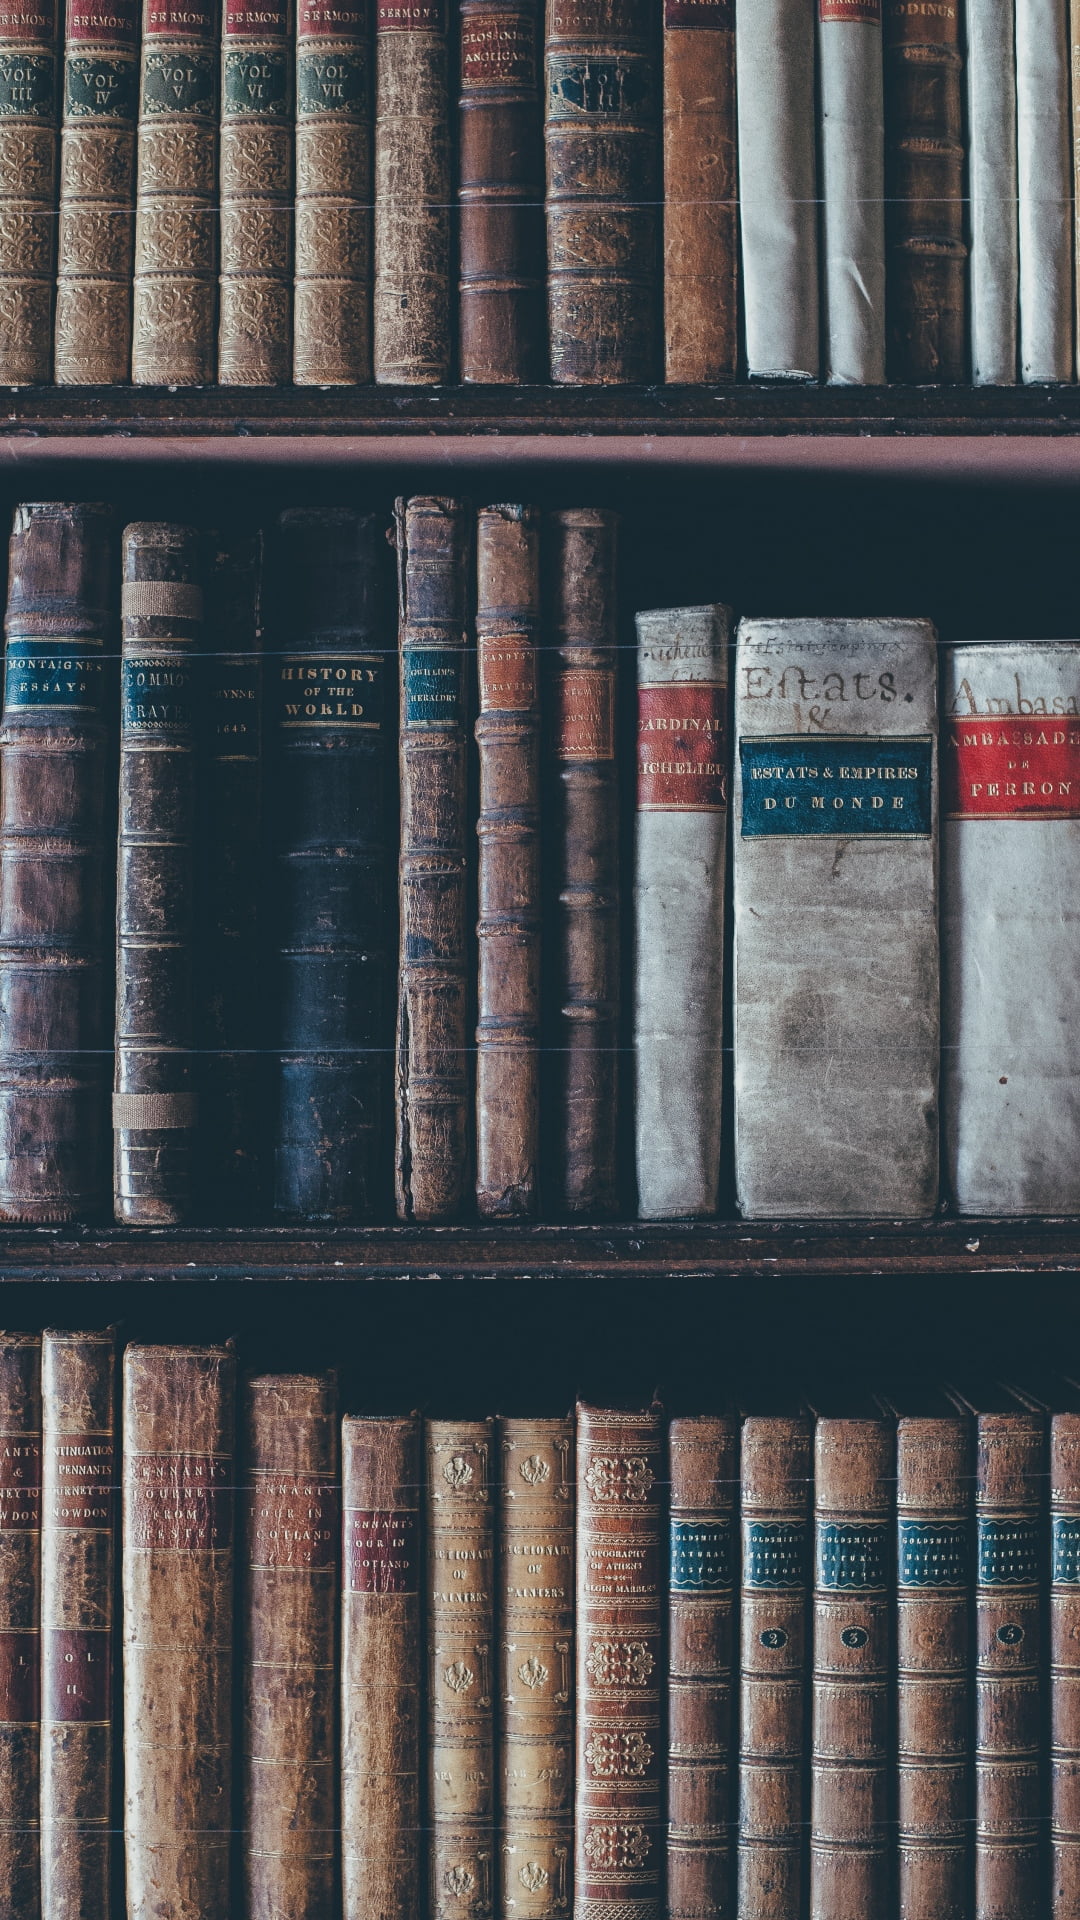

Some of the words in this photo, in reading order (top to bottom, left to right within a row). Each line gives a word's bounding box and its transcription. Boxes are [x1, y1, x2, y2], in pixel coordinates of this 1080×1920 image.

[150, 12, 210, 25] SERMONS
[228, 12, 287, 25] SERMONS
[303, 10, 363, 25] SERMONS
[380, 7, 440, 19] SERMONS
[0, 14, 53, 27] ERMONS
[73, 15, 134, 30] SERMONS
[2, 69, 37, 81] VOL
[161, 69, 197, 83] VOL
[239, 66, 272, 79] VOL
[314, 66, 349, 79] VOL
[83, 74, 119, 88] VOL
[10, 88, 32, 101] III
[172, 86, 184, 99] V
[247, 84, 264, 98] VI
[321, 84, 344, 97] VII
[95, 91, 111, 105] IV
[281, 667, 378, 683] HISTORY
[20, 681, 88, 693] ESSAYS
[303, 687, 326, 697] OF
[328, 687, 355, 697] THE
[484, 682, 533, 692] TRAVELS
[411, 694, 457, 702] HERALDRY
[950, 672, 1080, 715] Ambasa
[124, 703, 192, 719] PRAYE
[285, 703, 364, 716] WORLD
[1008, 760, 1029, 769] DE
[751, 767, 819, 779] ESTATS
[823, 768, 834, 778] &
[839, 766, 918, 780] EMPIRES
[971, 781, 1072, 797] PERRON
[764, 796, 797, 810] DU
[811, 796, 904, 809] MONDE
[4, 1443, 39, 1457] ANT'S
[52, 1445, 114, 1457] NTINUATION
[13, 1467, 23, 1478] &
[142, 1462, 227, 1478] ENNANT'S
[0, 1510, 39, 1521] WDON
[52, 1507, 108, 1519] NOWDON
[153, 1509, 198, 1520] FROM
[249, 1507, 294, 1519] TOUR
[307, 1508, 323, 1519] IN
[354, 1516, 414, 1529] ENNANT'S
[142, 1528, 218, 1541] HESTER
[256, 1530, 332, 1541] COTLAND
[392, 1538, 405, 1548] IN
[428, 1548, 494, 1561] DICTIONARY
[500, 1544, 571, 1557] DICTIONARY
[586, 1549, 647, 1559] TOPOGRAPHY
[672, 1550, 726, 1559] NATURAL
[749, 1552, 799, 1560] NATURAL
[984, 1549, 1035, 1559] NATURAL
[822, 1554, 880, 1562] NATURAL
[906, 1553, 960, 1562] NATURAL
[354, 1559, 410, 1569] COTLAND
[528, 1564, 543, 1574] OF
[590, 1562, 603, 1570] OF
[606, 1561, 643, 1571] ATHENS
[672, 1566, 729, 1574] HISTORY
[981, 1562, 1038, 1573] HISTORY
[453, 1569, 467, 1580] OF
[748, 1567, 802, 1575] HISTORY
[821, 1569, 884, 1578] HISTORY
[904, 1568, 964, 1577] HISTORY
[433, 1591, 488, 1603] PAINTERS
[768, 1632, 778, 1646] 2
[849, 1633, 859, 1645] 3
[1005, 1627, 1015, 1640] 5
